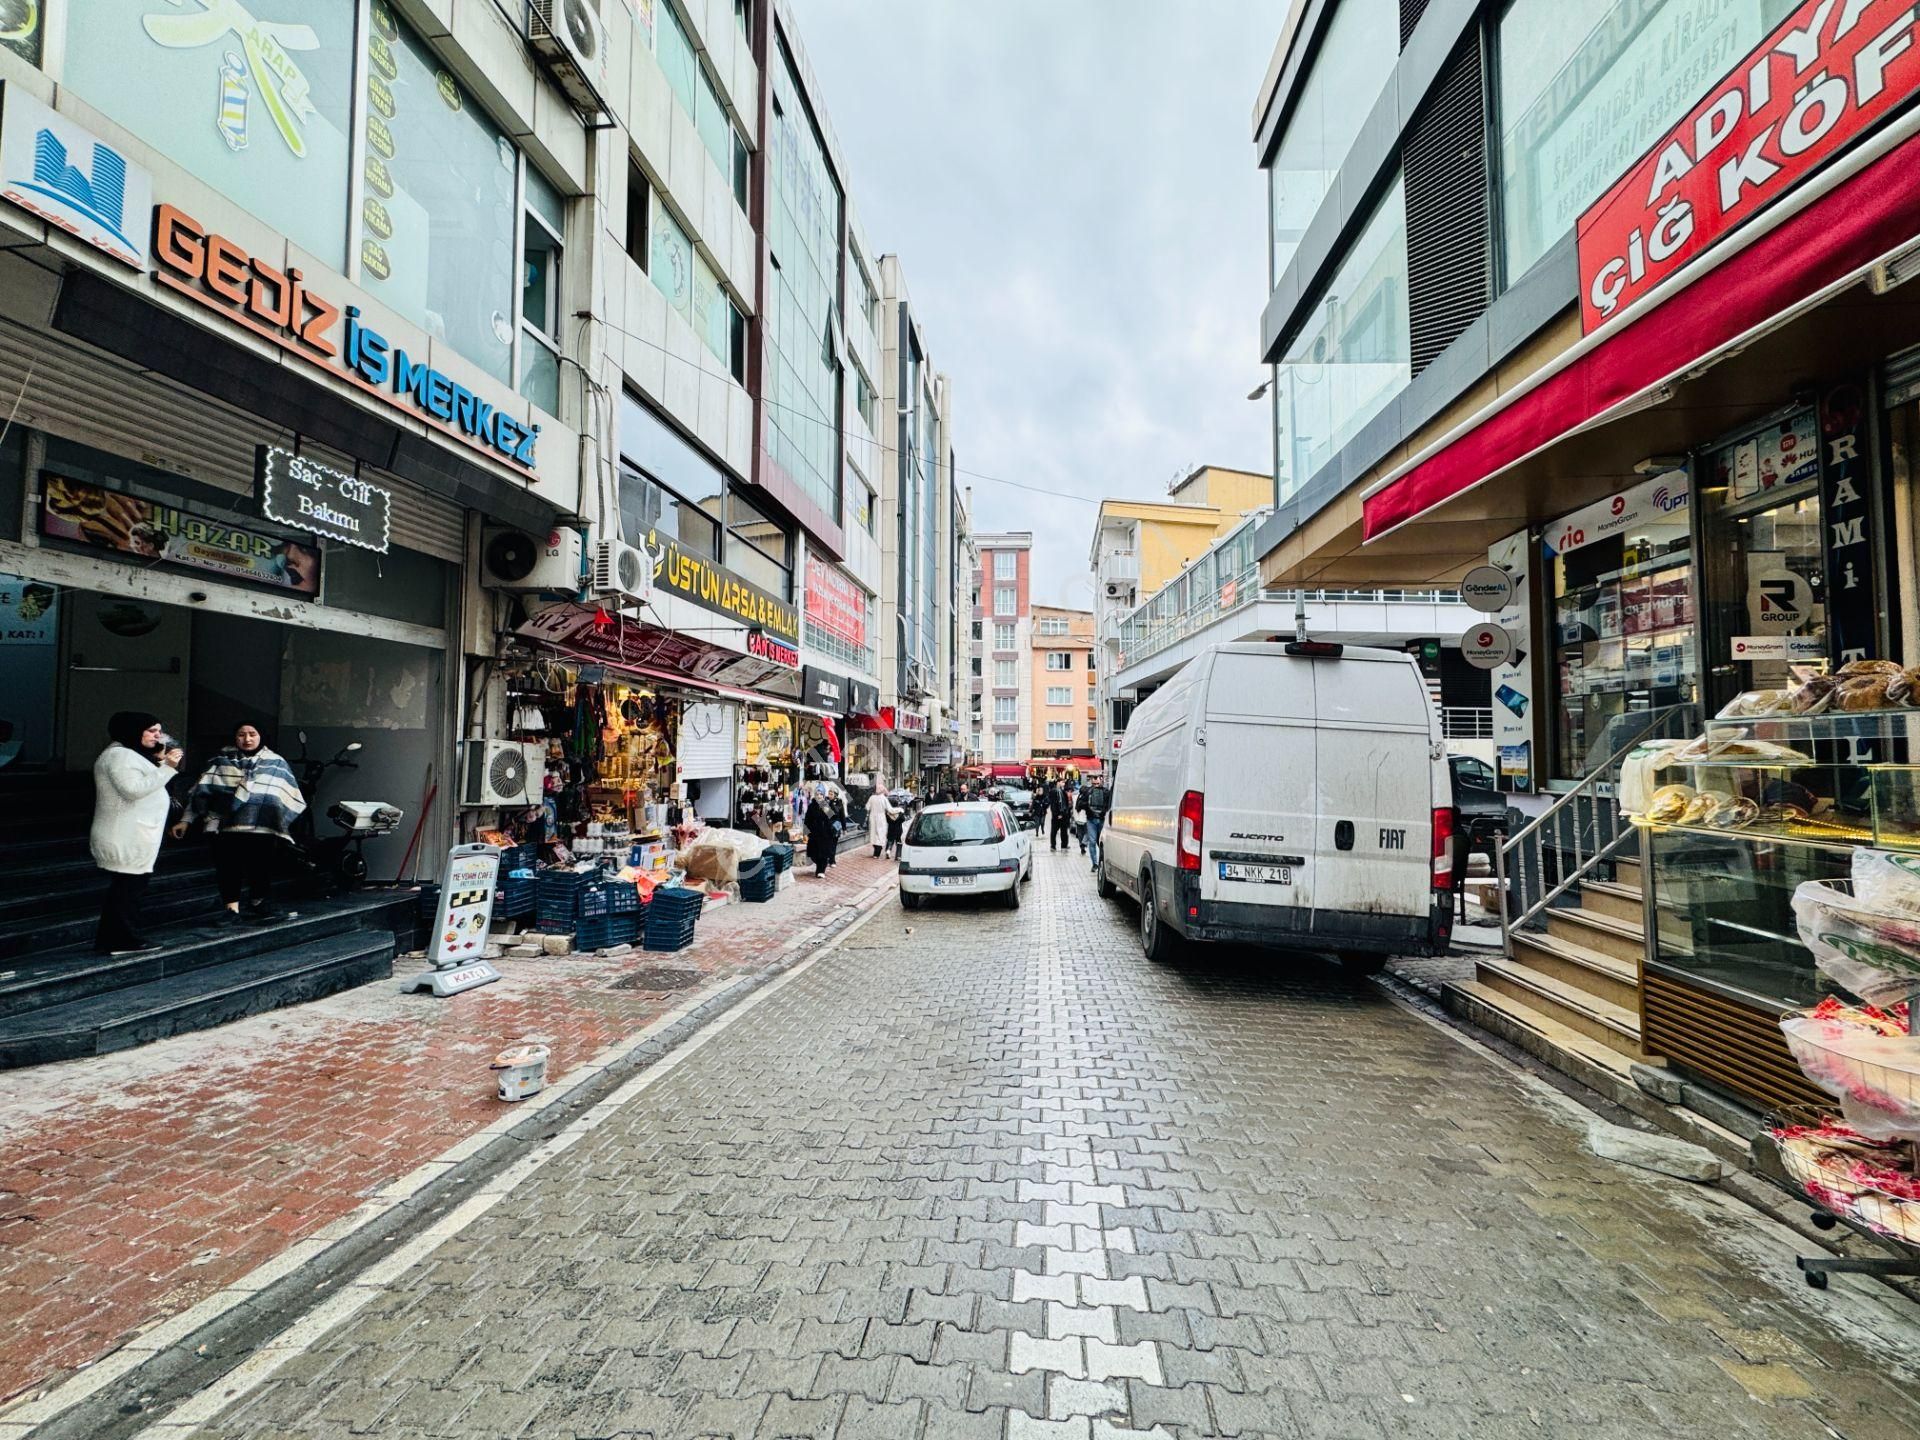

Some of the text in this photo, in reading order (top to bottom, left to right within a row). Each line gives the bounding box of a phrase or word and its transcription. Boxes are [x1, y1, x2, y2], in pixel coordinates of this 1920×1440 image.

[246, 27, 297, 80] ARAP
[1590, 192, 1694, 317] ÇİĞ
[151, 203, 542, 471] GEDİZ İŞ MERKEZİ
[288, 459, 322, 491] Saç
[338, 480, 372, 506] Cilt
[1663, 492, 1688, 512] UPT
[297, 494, 360, 532] Bakımı
[1597, 511, 1638, 532] MoneyGram
[146, 505, 272, 559] HAZAR
[1559, 525, 1585, 551] ria
[175, 552, 190, 563] Kat
[545, 549, 560, 558] LG
[668, 541, 720, 606] ÜSTÜN
[721, 578, 757, 622] ARSA
[758, 596, 767, 625] &
[767, 600, 799, 641] EMLAK
[1465, 582, 1508, 592] GönderAL
[1760, 580, 1799, 612] R
[1761, 612, 1800, 622] GROUP
[8, 630, 36, 640] KAT:
[1466, 648, 1504, 657] MoneyGram
[1747, 644, 1784, 655] MoneyGram
[1229, 828, 1407, 850] DUCATO FIAT
[477, 870, 494, 880] CAFE
[1226, 862, 1239, 878] 34
[1244, 865, 1264, 879] NKK
[1269, 867, 1290, 881] 218
